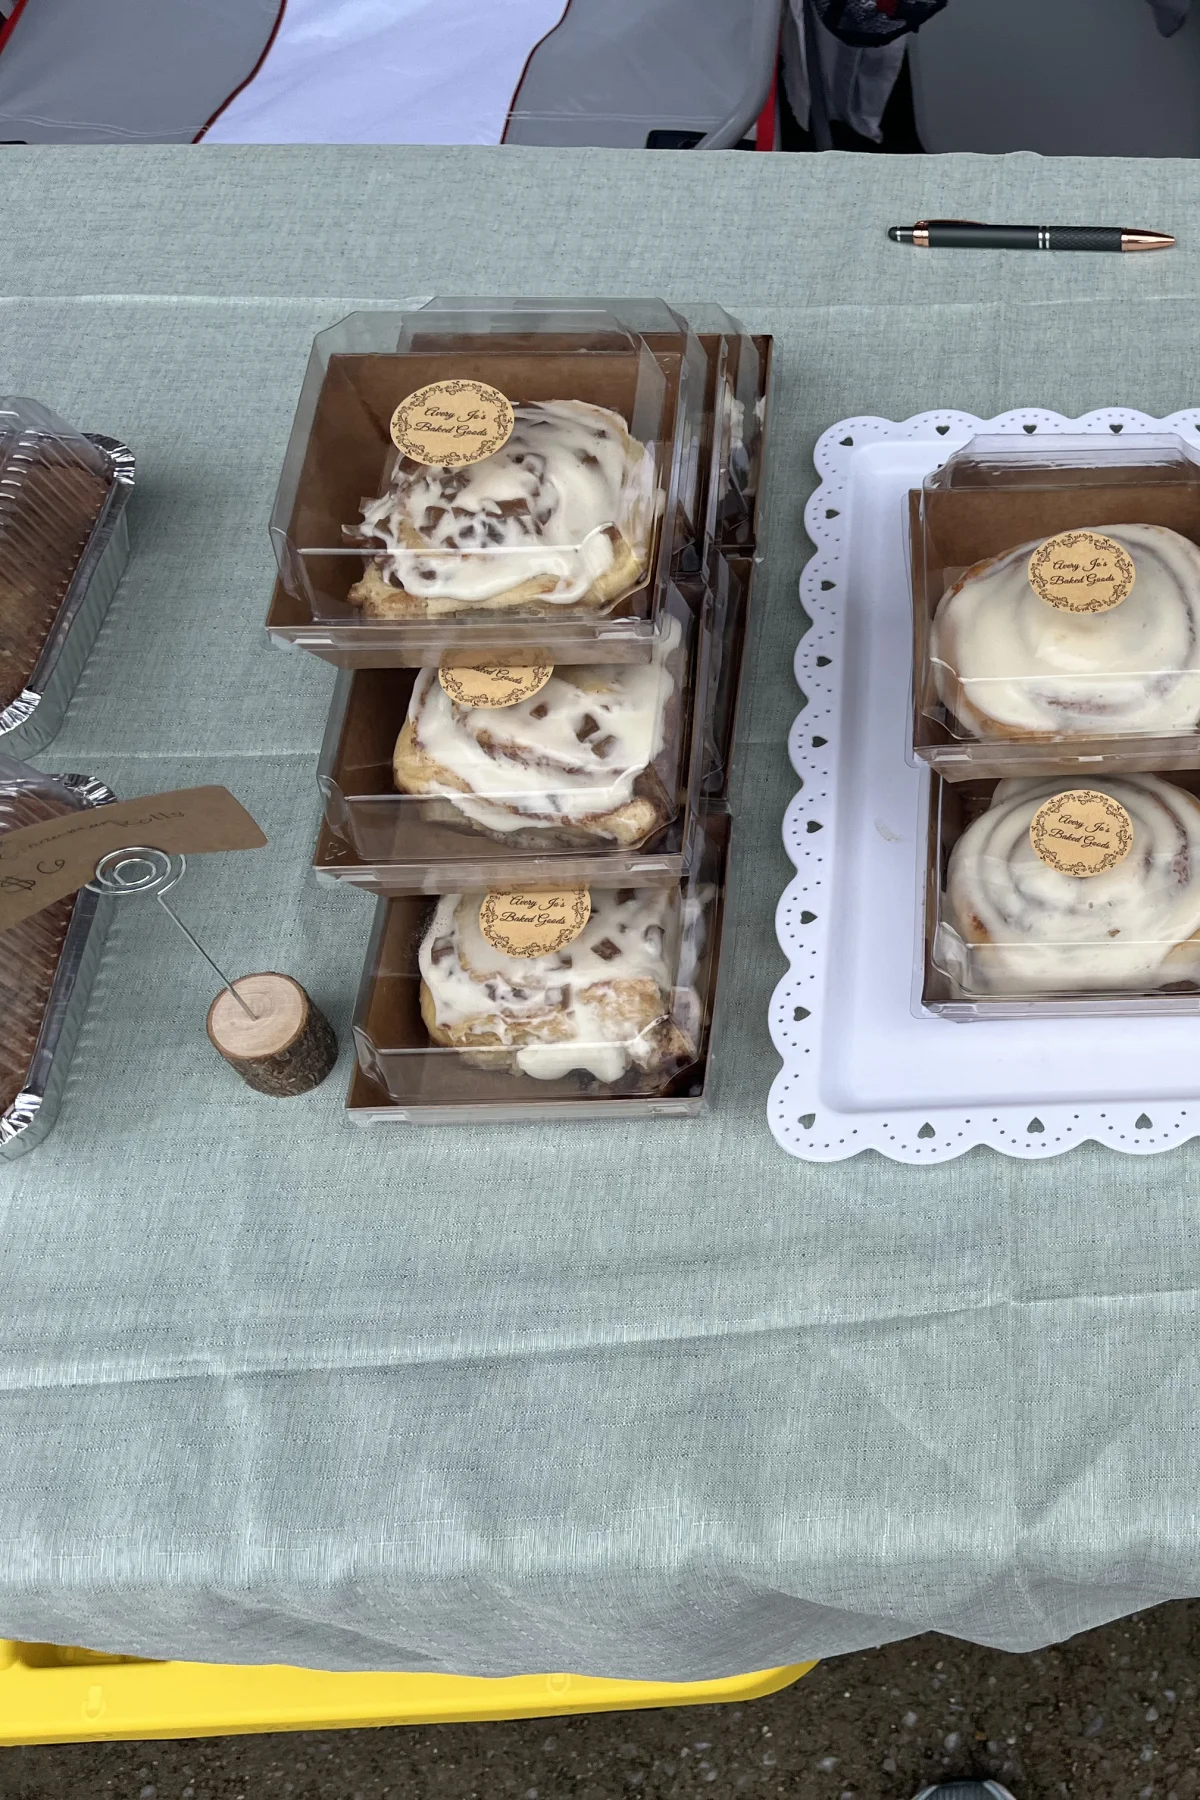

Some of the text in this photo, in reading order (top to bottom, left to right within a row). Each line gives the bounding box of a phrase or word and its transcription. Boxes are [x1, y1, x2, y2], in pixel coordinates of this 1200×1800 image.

[424, 407, 487, 422] Avery Jo's
[413, 422, 488, 438] Baked Goods
[1052, 557, 1108, 572] Avery Jo's
[1050, 573, 1115, 587] Baked Goods
[491, 669, 524, 684] Goods
[1058, 814, 1110, 833] Avery Jo's
[1048, 828, 1111, 849] Baked Goods
[509, 895, 566, 911] Avery Jo's
[499, 911, 566, 927] Baked Goods
